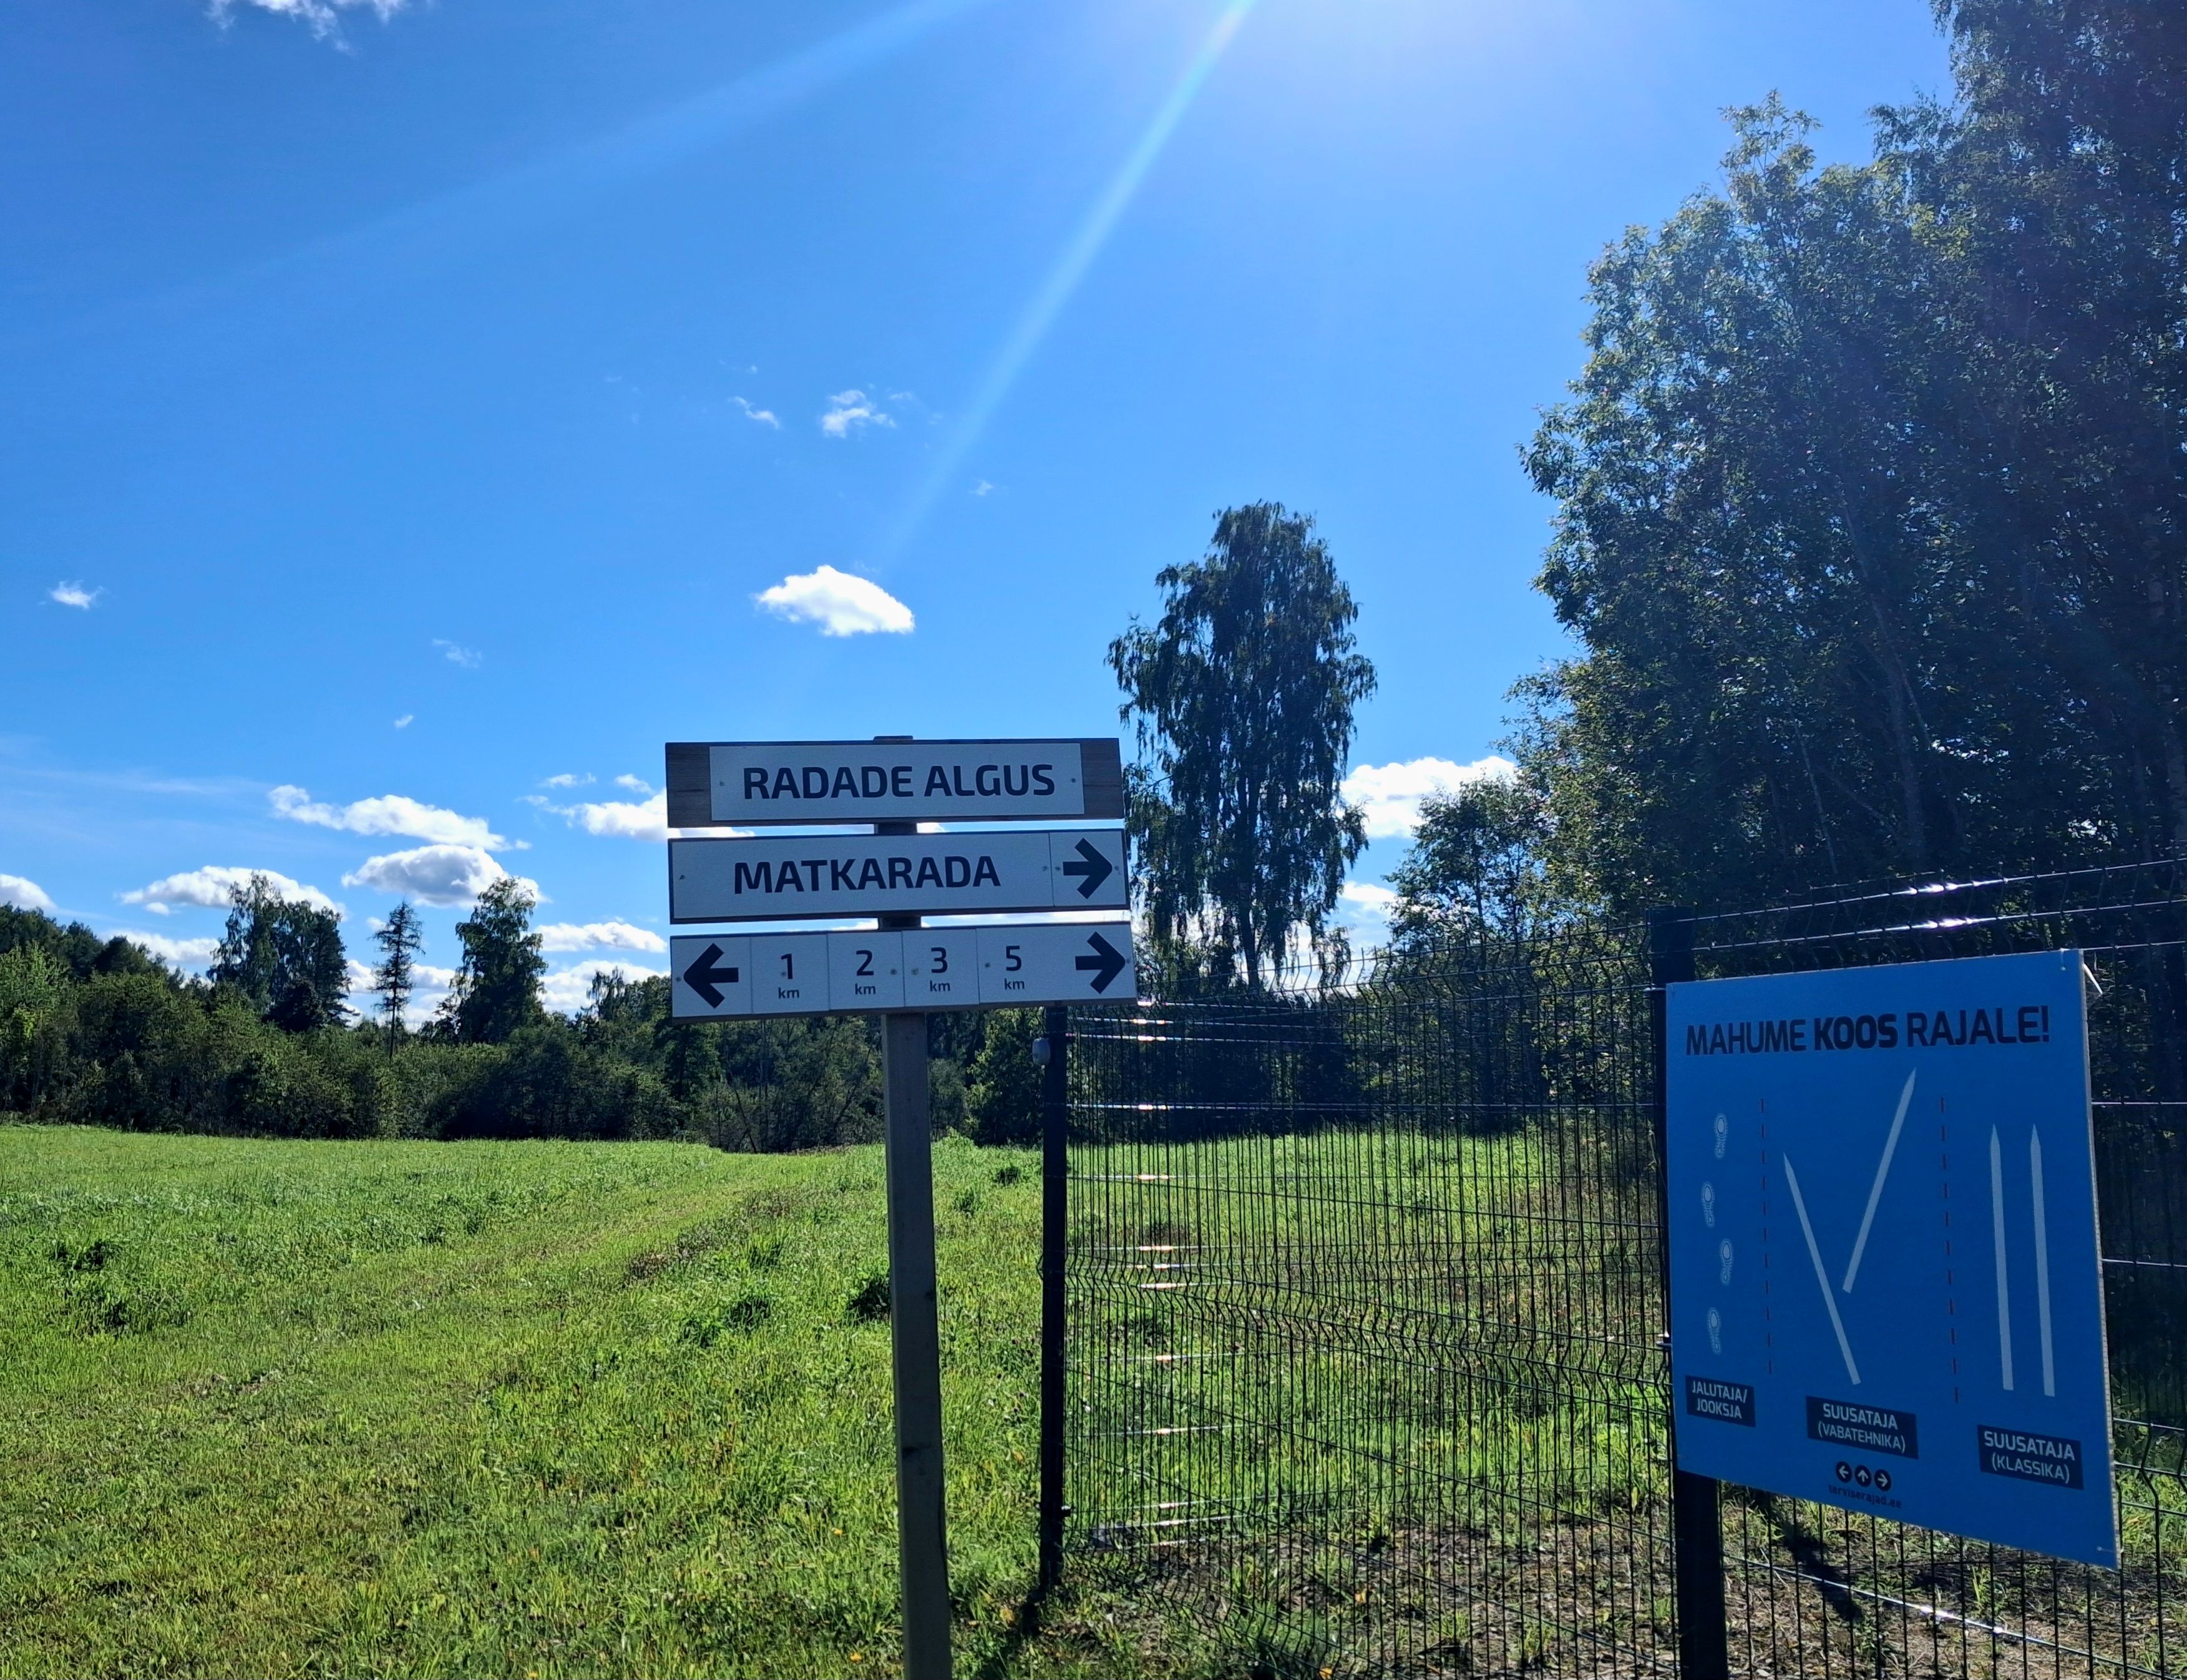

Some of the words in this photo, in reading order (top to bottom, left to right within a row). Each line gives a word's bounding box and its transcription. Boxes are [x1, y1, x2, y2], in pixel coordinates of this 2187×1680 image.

[743, 765, 913, 800] RADADE
[924, 764, 1055, 797] ALGUS
[734, 855, 1001, 894] MATKARADA
[781, 953, 793, 979] 1
[856, 949, 874, 976] 2
[931, 947, 948, 973] 3
[1005, 945, 1022, 971] 5
[778, 986, 800, 999] km
[855, 982, 876, 996] km
[930, 979, 950, 992] km
[1004, 977, 1025, 990] km
[1686, 1019, 1806, 1056] MAHUME
[1814, 1014, 1898, 1051] KOOS
[1907, 1005, 2050, 1047] RAJALE!
[1692, 1380, 1747, 1404] JALUTAJA/
[1697, 1399, 1742, 1419] JOOKSJA
[1823, 1403, 1898, 1430] SUUSATAJA
[1818, 1422, 1906, 1454] (VABATEHNIKA)
[1984, 1431, 2075, 1461] SUUSATAJA
[1992, 1452, 2070, 1484] (KLASSIKA)
[1829, 1484, 1902, 1509] terviserajad.ee
